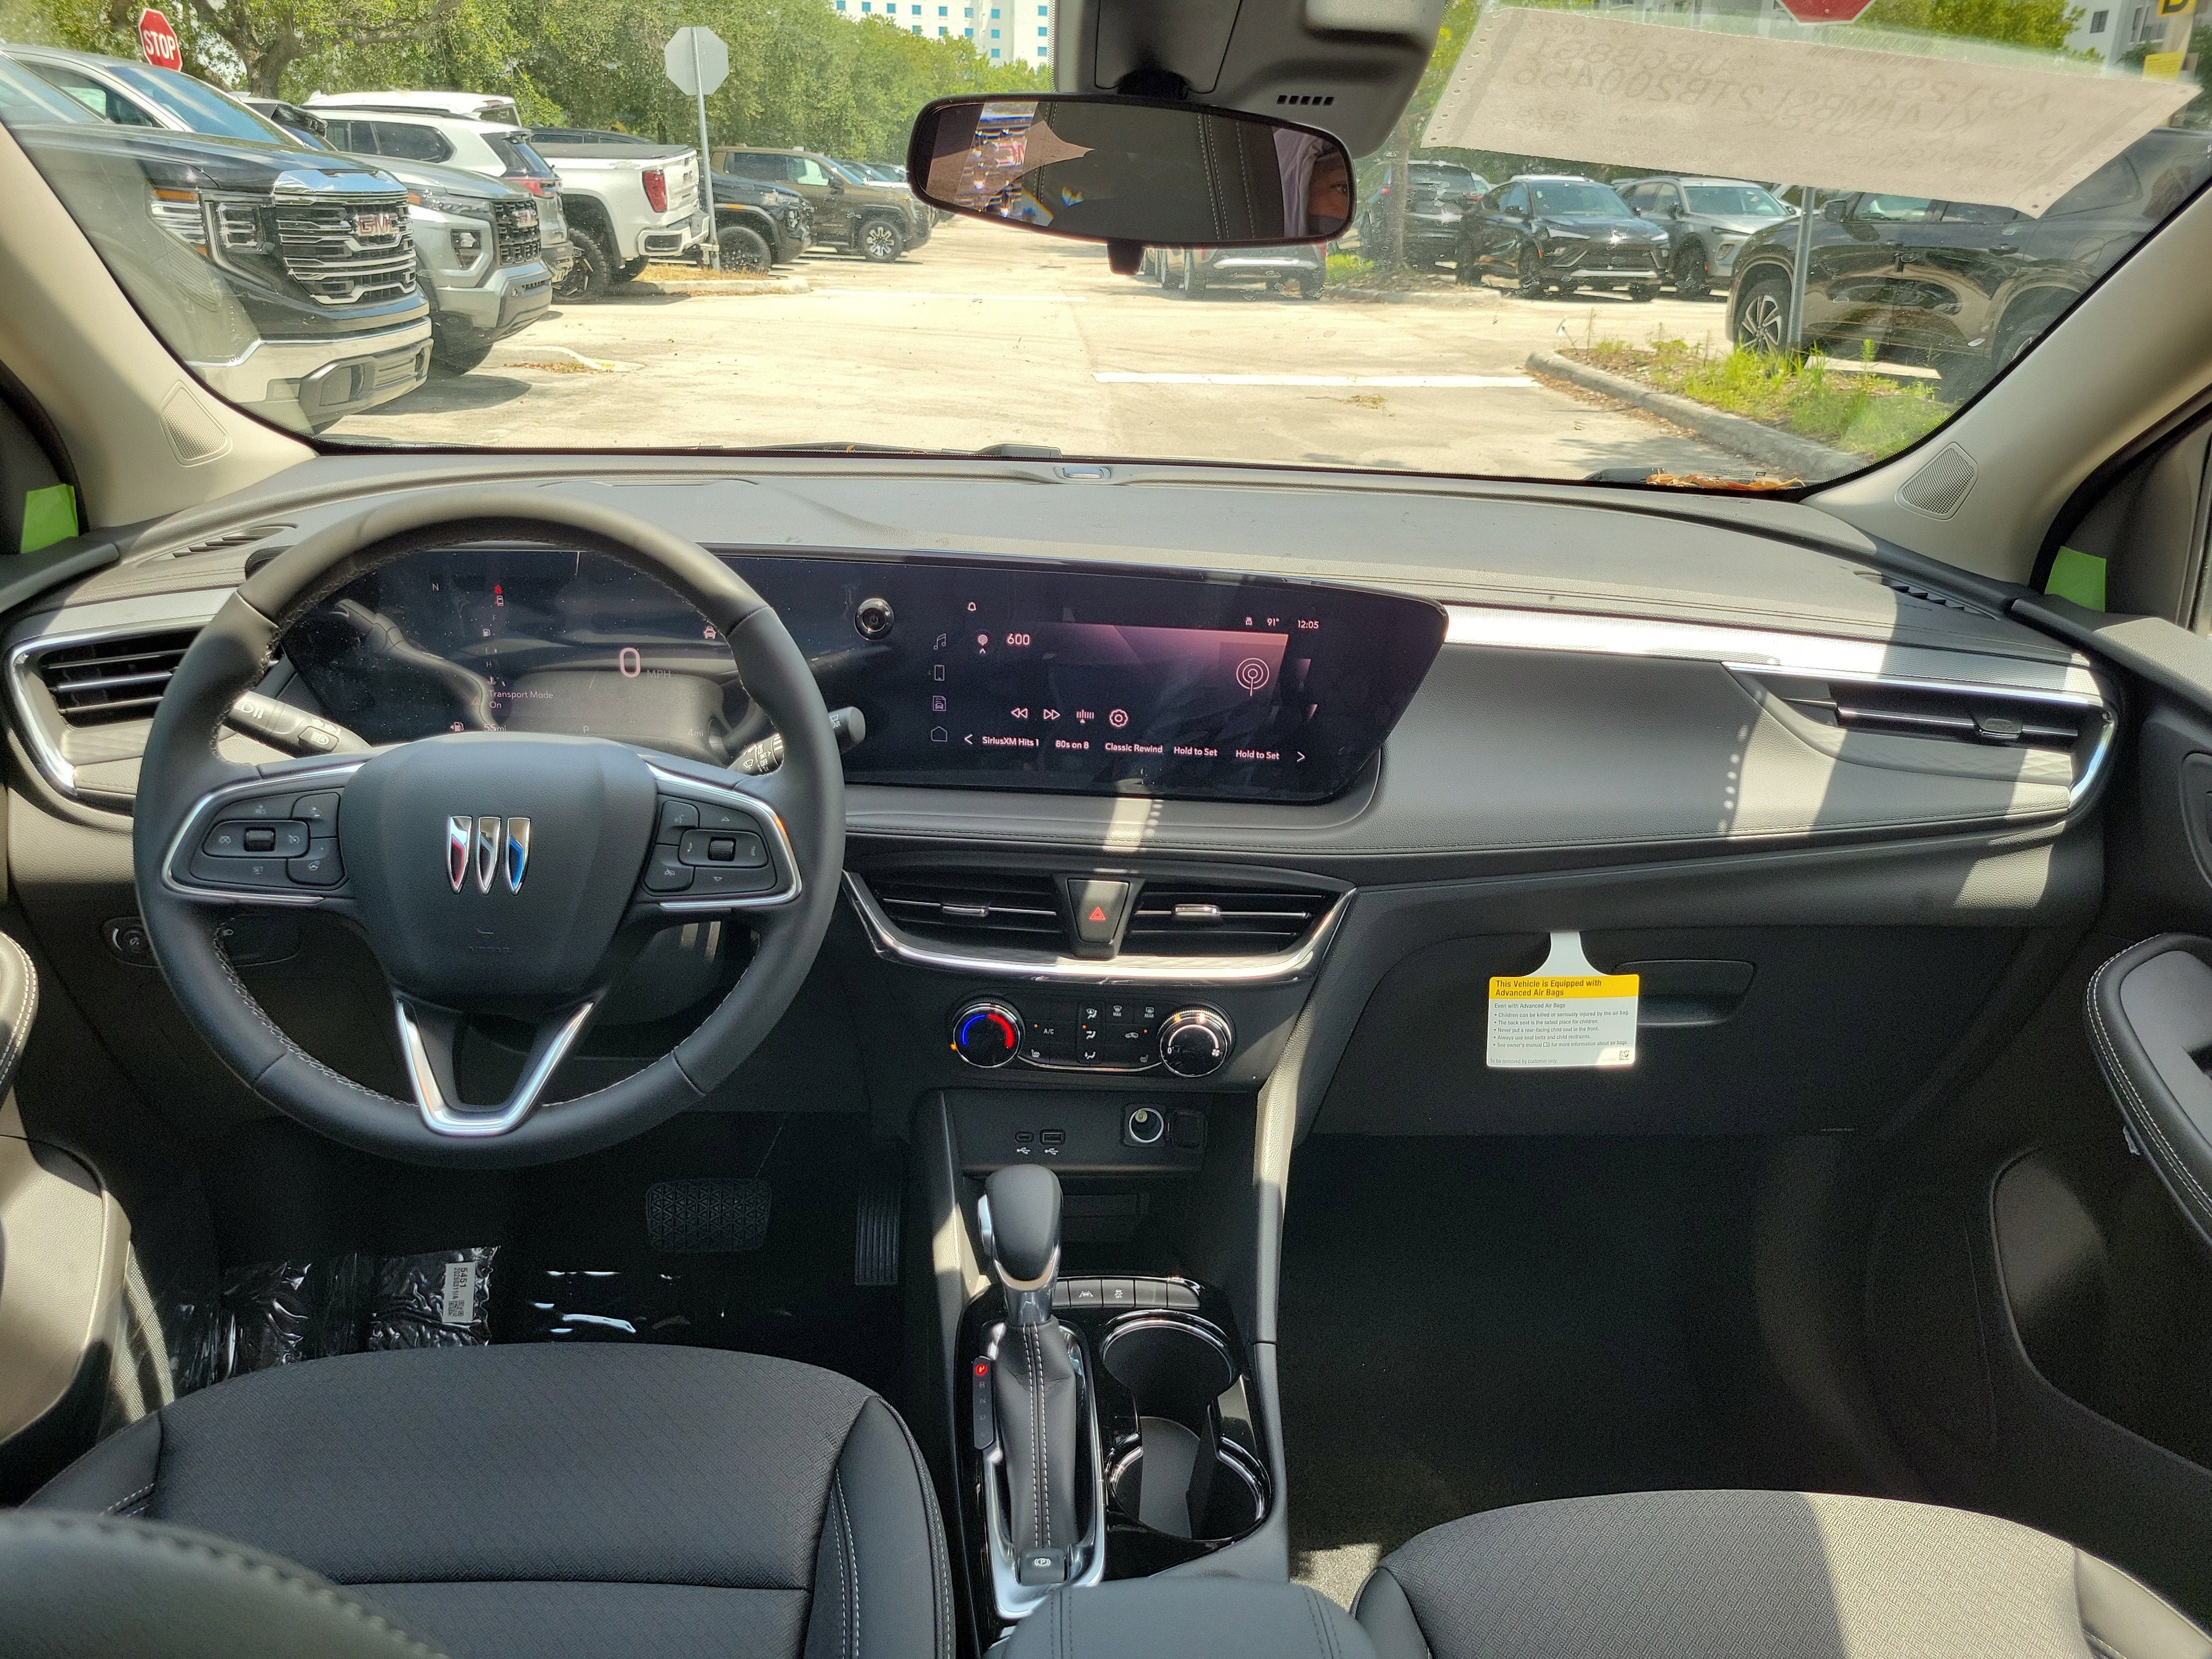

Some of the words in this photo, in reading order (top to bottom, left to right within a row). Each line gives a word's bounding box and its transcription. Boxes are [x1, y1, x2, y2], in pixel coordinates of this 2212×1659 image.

[144, 30, 176, 60] STOP
[358, 213, 400, 236] GMC
[1267, 618, 1279, 626] 91°
[1297, 619, 1319, 629] 12:05
[1007, 633, 1030, 646] 600
[620, 647, 641, 678] 0
[647, 670, 671, 678] MPH
[489, 690, 528, 699] Transport
[583, 725, 589, 733] P
[983, 736, 1016, 746] SiriusXM
[1018, 738, 1034, 746] Hits
[1056, 740, 1070, 748] 80s
[1105, 742, 1132, 752] Classic
[1134, 744, 1163, 753] Rewind
[1174, 747, 1192, 755] Hold
[1204, 748, 1218, 757] Set
[1235, 750, 1254, 758] Hold
[1550, 979, 1584, 988] Equipped
[460, 1267, 468, 1288] 5451
